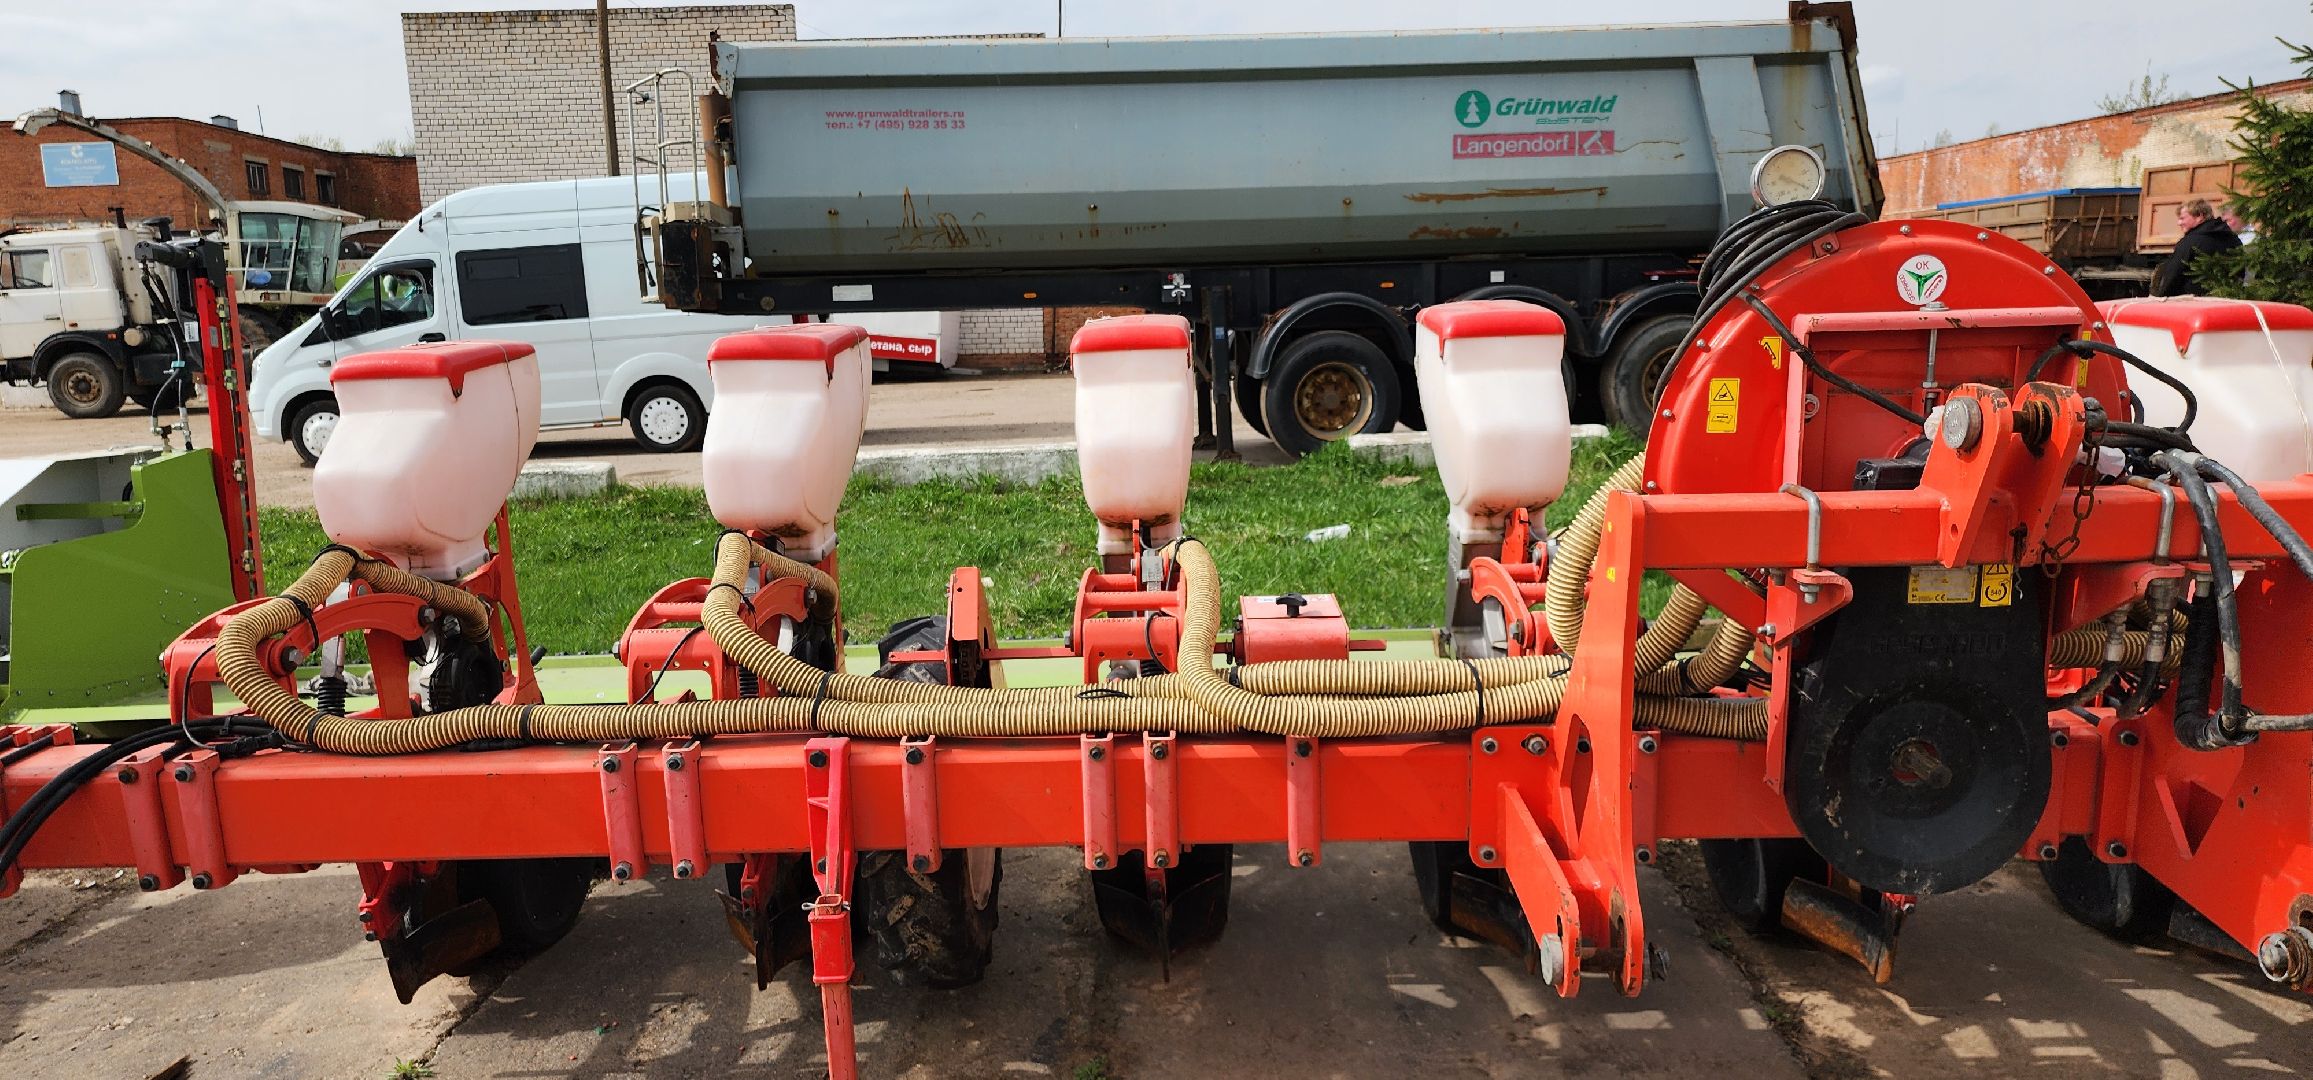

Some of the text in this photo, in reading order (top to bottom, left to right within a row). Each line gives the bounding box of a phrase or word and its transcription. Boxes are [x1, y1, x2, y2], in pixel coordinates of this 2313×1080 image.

[1496, 95, 1618, 116] Grünwald
[825, 109, 965, 119] www.grunwaldtrailers.ru
[857, 120, 870, 129] +7
[874, 120, 904, 131] (495)
[908, 120, 929, 129] 928
[933, 120, 947, 129] 35
[951, 120, 965, 129] 33
[1457, 134, 1569, 157] Langendorf
[1915, 261, 1929, 270] OK
[908, 344, 932, 356] сыр
